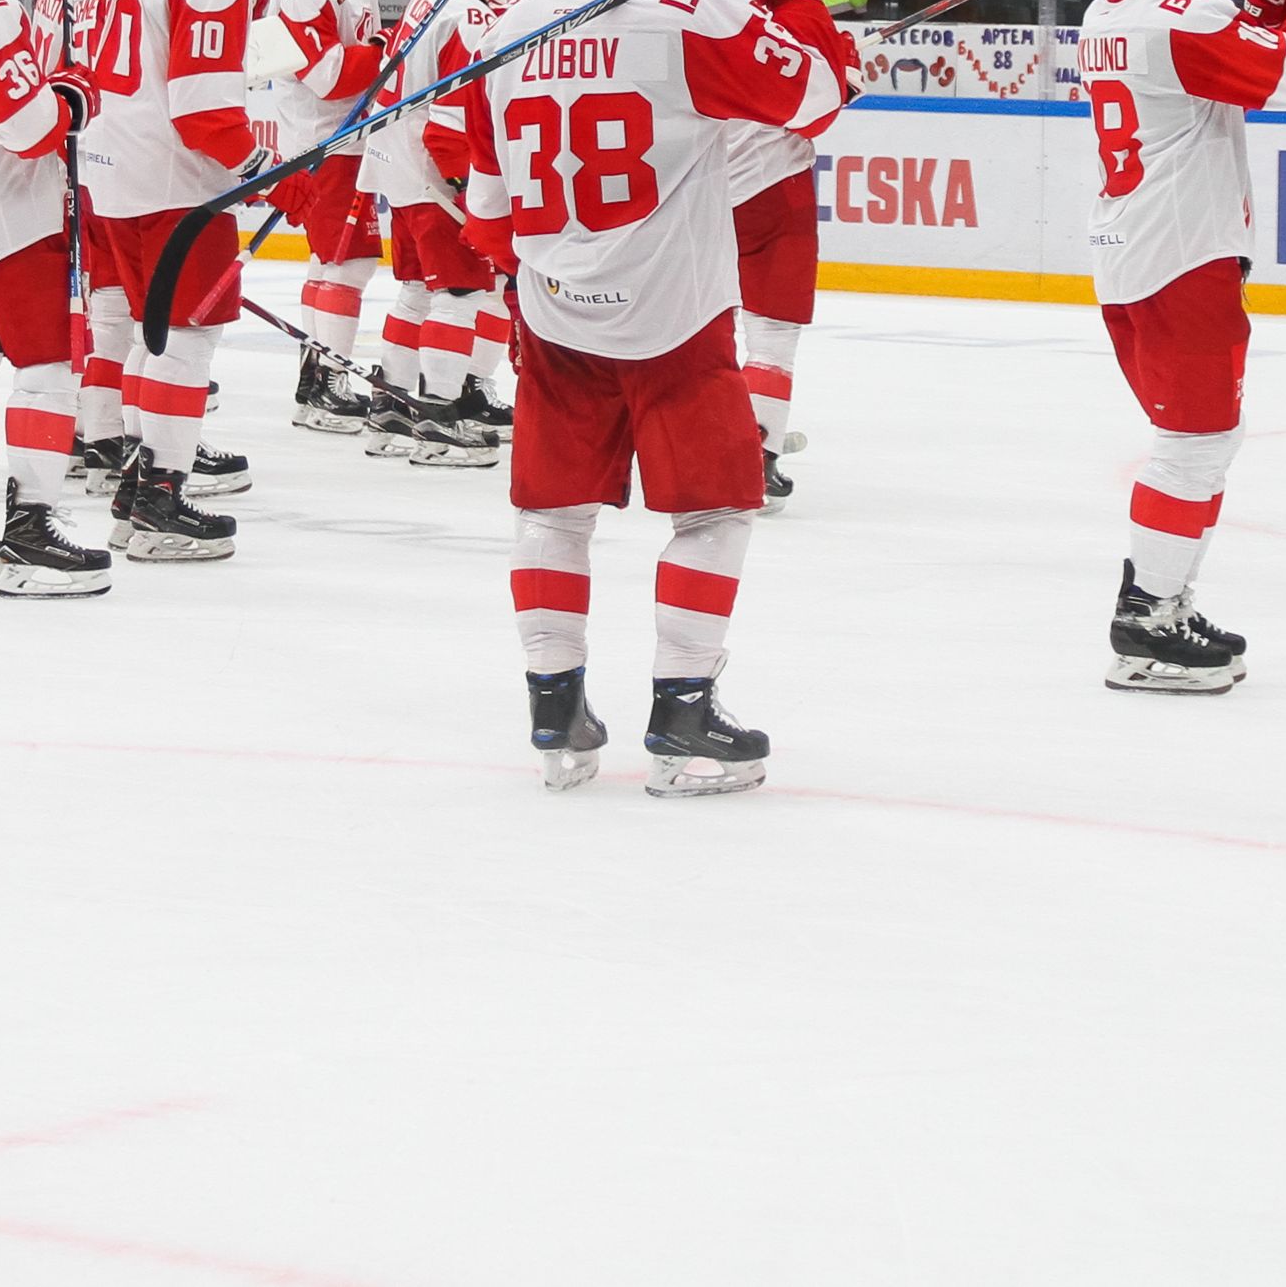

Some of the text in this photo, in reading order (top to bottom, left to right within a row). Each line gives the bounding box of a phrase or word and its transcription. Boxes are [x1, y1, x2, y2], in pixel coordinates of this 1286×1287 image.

[189, 20, 226, 60] 10
[981, 28, 1035, 45] АРТЕМ
[521, 37, 620, 84] ZUBOV
[993, 50, 1013, 70] 88
[1083, 79, 1145, 199] 8
[504, 91, 660, 238] 38
[836, 155, 980, 228] CSKA
[565, 289, 629, 306] ERIELL
